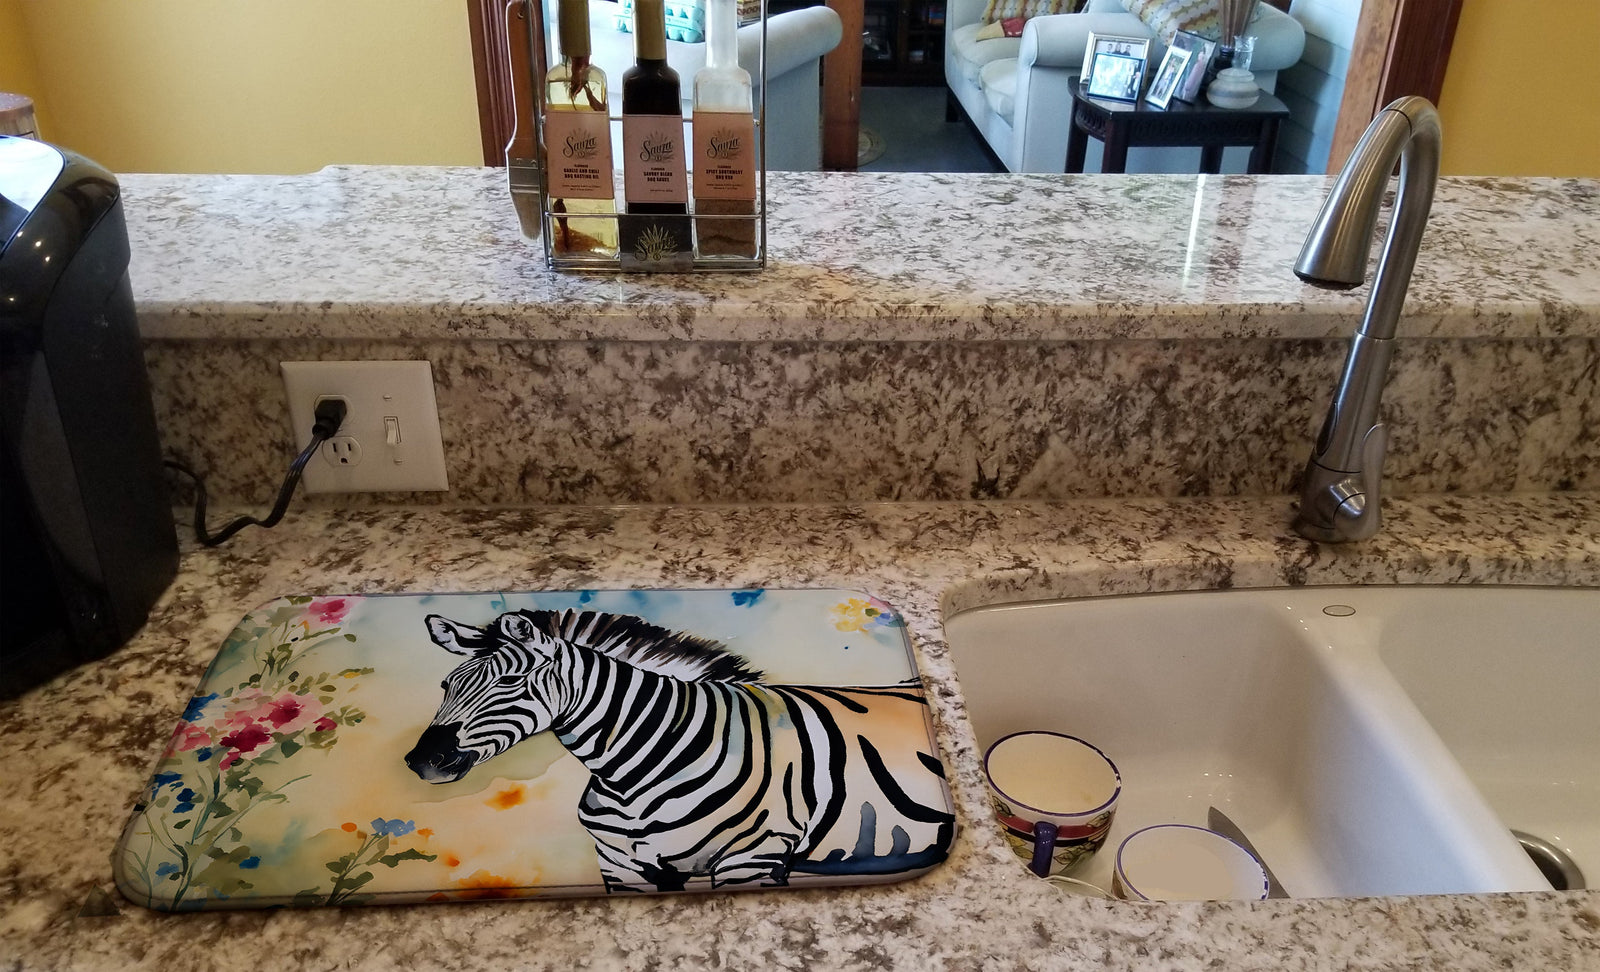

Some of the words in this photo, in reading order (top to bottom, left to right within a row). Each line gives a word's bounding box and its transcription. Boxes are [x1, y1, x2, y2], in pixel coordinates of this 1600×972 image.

[562, 135, 598, 158] Sauza
[639, 140, 673, 162] Sauza
[706, 136, 740, 159] Sauza
